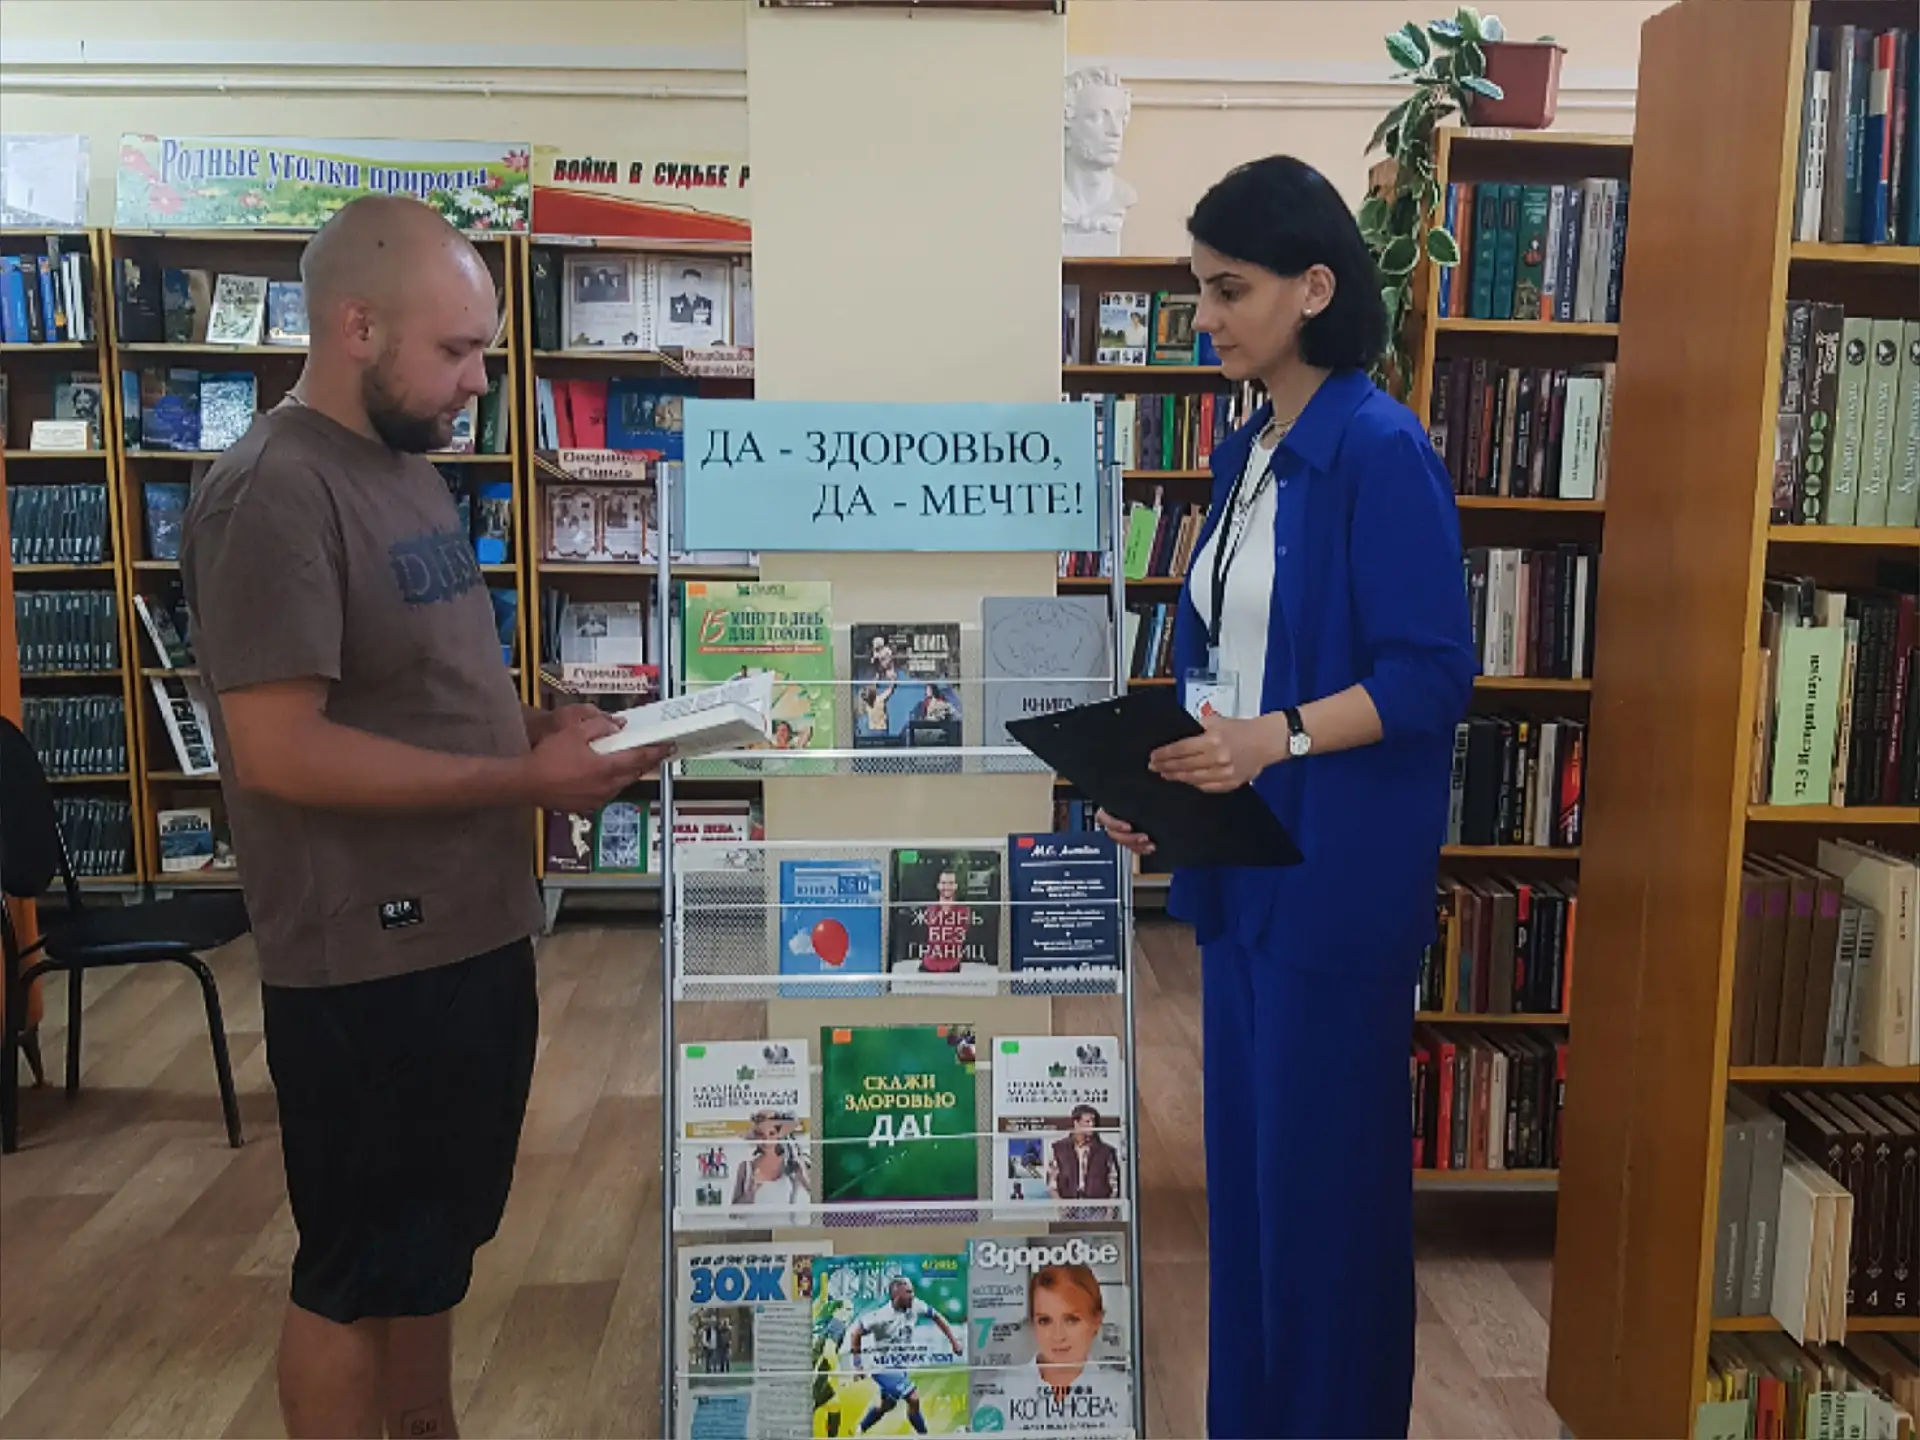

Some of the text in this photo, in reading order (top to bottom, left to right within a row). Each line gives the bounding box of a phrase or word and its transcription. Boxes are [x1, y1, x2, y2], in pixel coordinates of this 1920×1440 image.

[161, 139, 488, 198] Родные уголки природы
[554, 157, 618, 184] ВОЙНА
[629, 162, 643, 184] В
[654, 162, 730, 190] СУДЬБЕ
[700, 429, 765, 470] ДА
[806, 429, 1063, 471] ЗДОРОВЬЮ,
[812, 484, 877, 523] ДА
[920, 482, 1083, 517] МЕЧТЕ!
[699, 608, 729, 643] 15
[911, 909, 984, 926] ЖИЗНЬ
[928, 926, 967, 943] БЕЗ
[908, 942, 986, 961] ГРАНИЦ
[863, 1074, 936, 1090] СКАЖИ
[845, 1092, 956, 1113] ЗДОРОВЬЮ
[868, 1112, 933, 1148] ДА!
[976, 1238, 1119, 1274] Здоровье
[690, 1266, 789, 1303] ЗОЖ
[1866, 1290, 1878, 1306] 4
[1894, 1292, 1906, 1308] 5
[973, 1317, 996, 1349] 7
